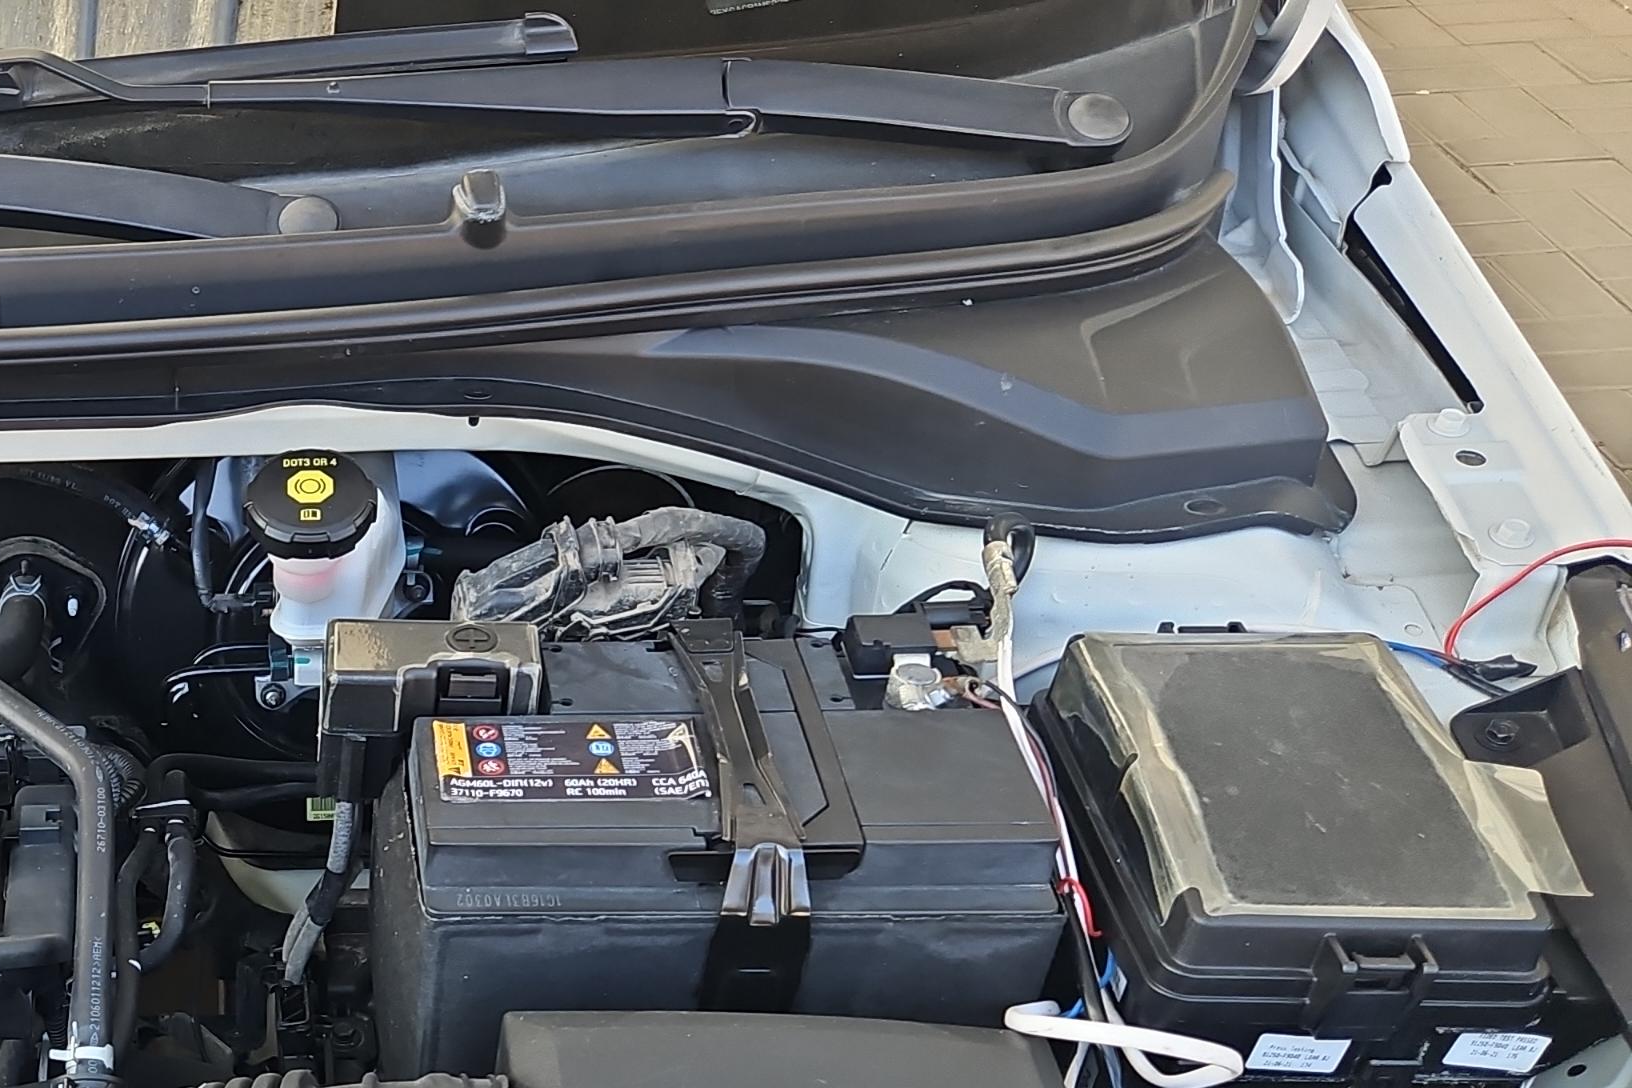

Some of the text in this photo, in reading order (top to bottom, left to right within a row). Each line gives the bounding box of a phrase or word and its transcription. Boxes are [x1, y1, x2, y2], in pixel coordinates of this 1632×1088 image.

[282, 458, 337, 467] DOT3 OR 4
[564, 778, 594, 787] 60Ah
[597, 778, 637, 787] (20HR)
[652, 778, 677, 786] CCA
[451, 787, 524, 798] 37110-F9670
[566, 788, 583, 796] RC
[586, 787, 627, 796] 100min
